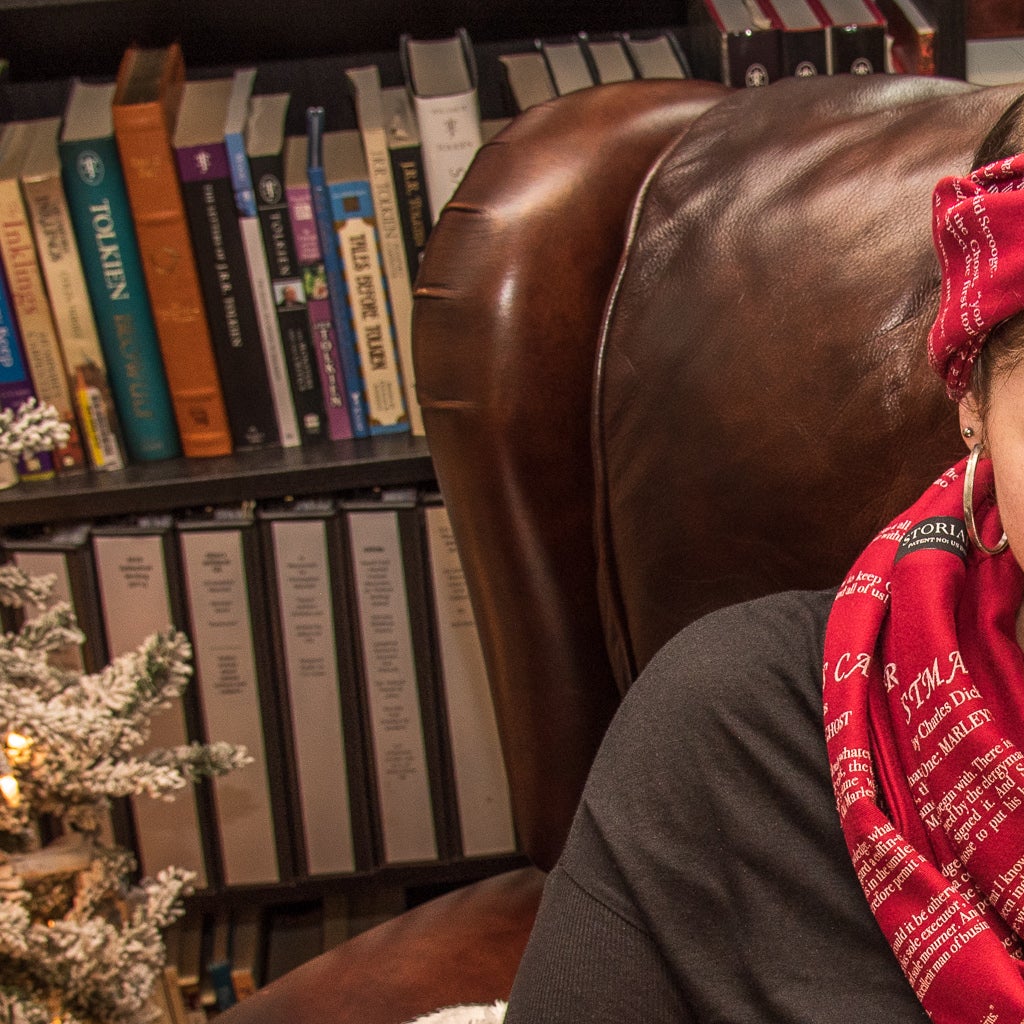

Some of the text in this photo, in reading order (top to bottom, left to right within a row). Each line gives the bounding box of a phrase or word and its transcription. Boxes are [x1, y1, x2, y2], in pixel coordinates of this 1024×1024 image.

[88, 197, 131, 300] TOLKIEN
[972, 743, 1004, 771] There
[966, 785, 983, 805] the
[975, 792, 1022, 842] to put his
[912, 910, 928, 927] be
